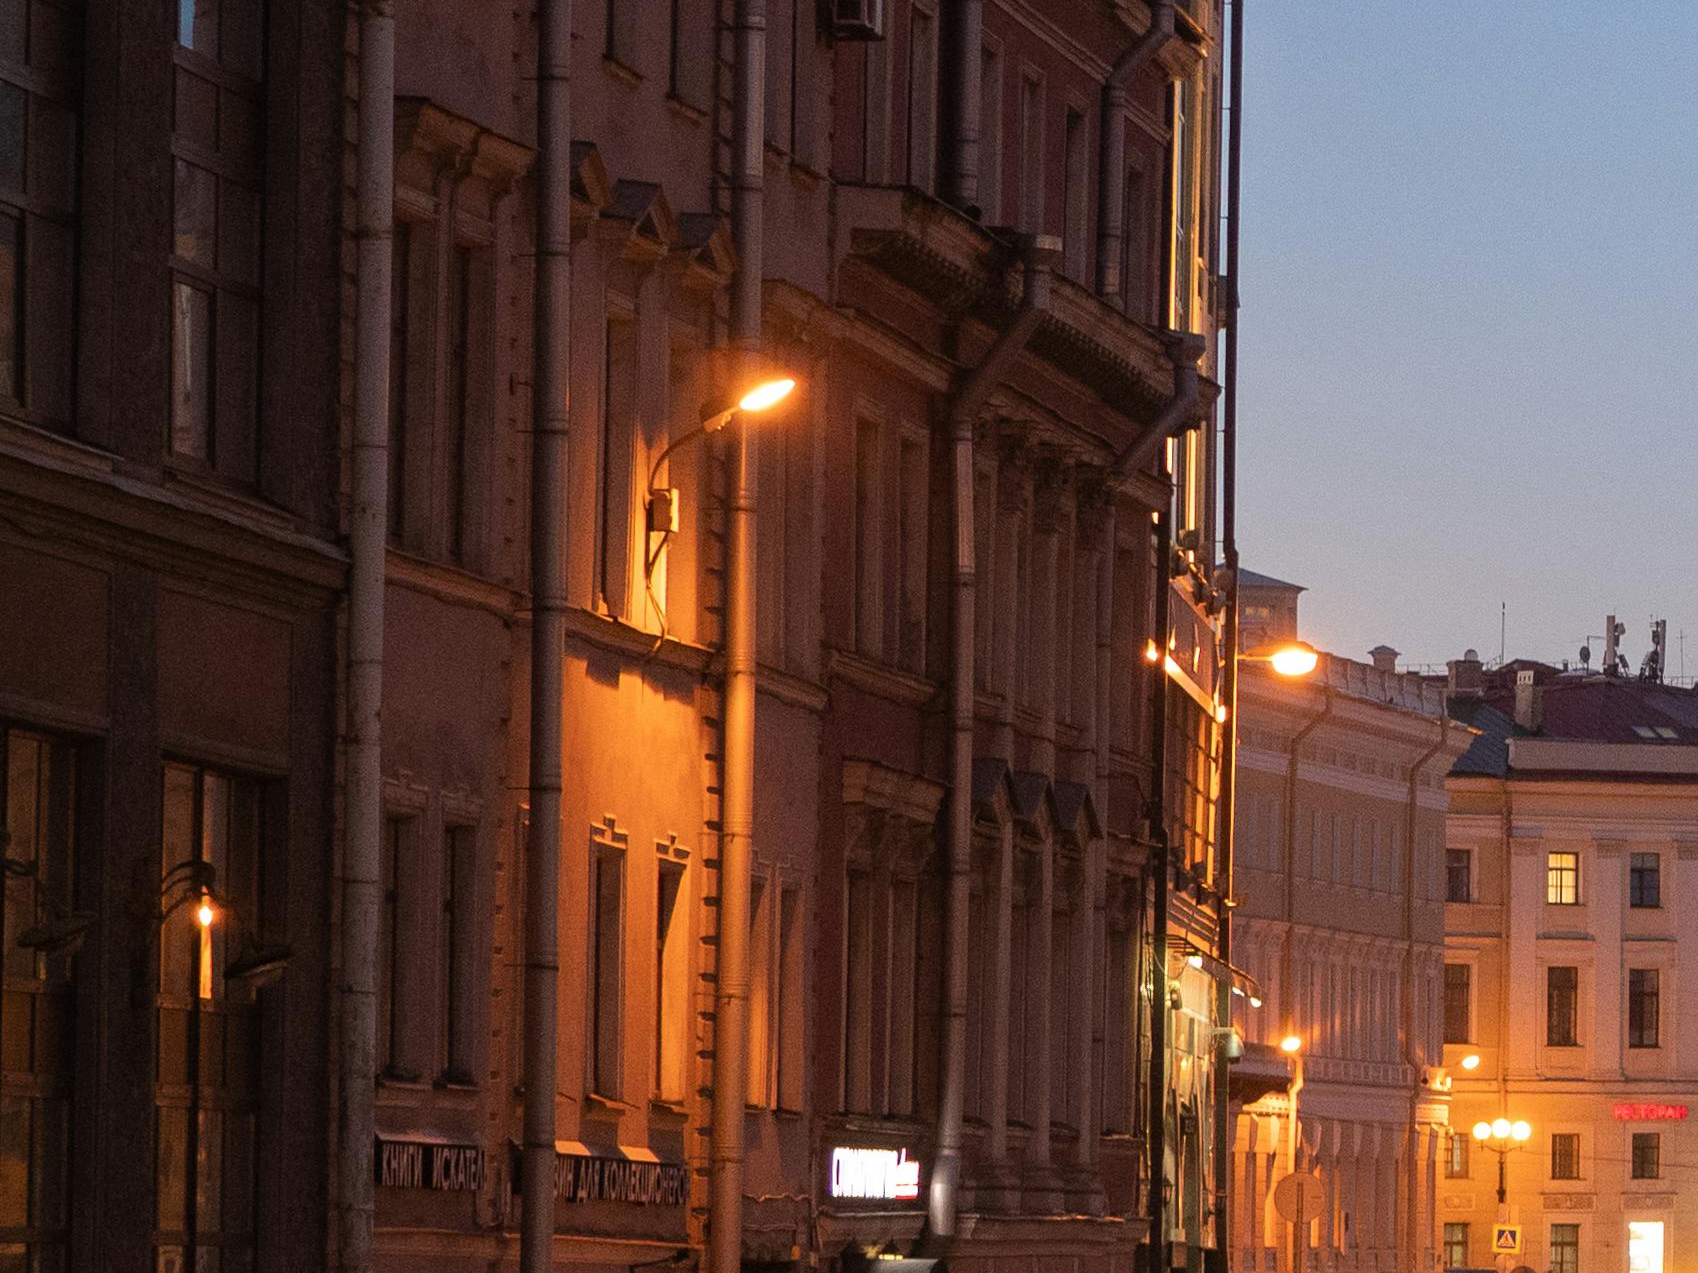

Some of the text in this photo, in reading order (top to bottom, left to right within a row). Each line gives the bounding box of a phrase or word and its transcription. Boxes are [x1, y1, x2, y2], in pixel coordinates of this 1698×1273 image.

[382, 1143, 486, 1190] КНИГИ ИСКАТЕЛ
[577, 1159, 600, 1203] ДЛЯ
[603, 1161, 689, 1207] КОЛЛЕКЦИОНЕРО
